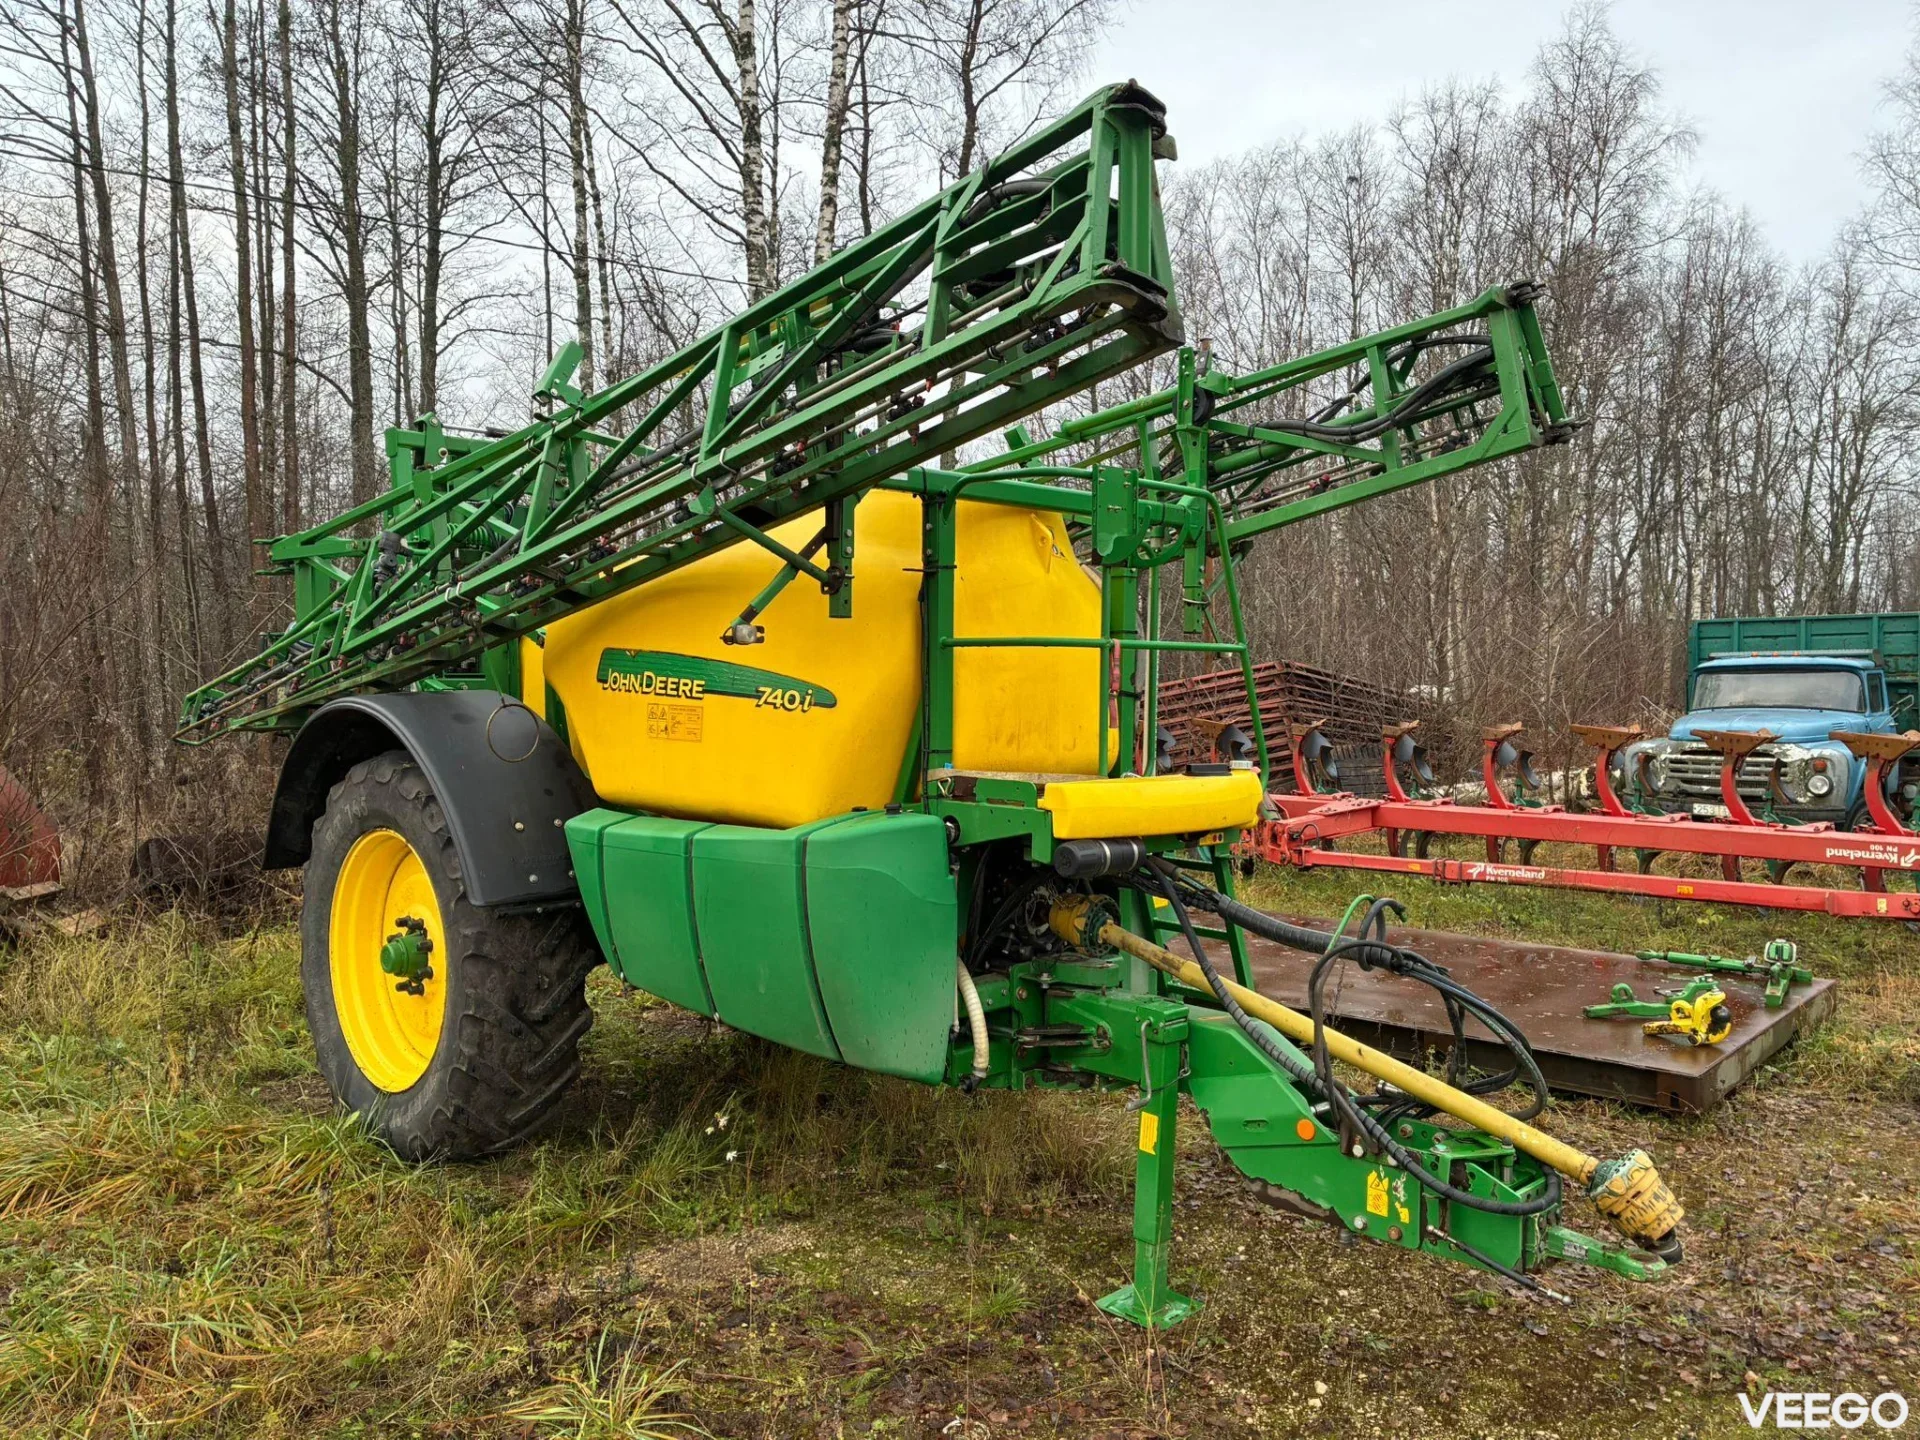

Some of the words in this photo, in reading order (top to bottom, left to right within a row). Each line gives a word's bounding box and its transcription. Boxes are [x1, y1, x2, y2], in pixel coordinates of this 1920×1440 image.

[602, 668, 641, 693] JOHN
[641, 671, 706, 700] DEERE
[1825, 847, 1899, 863] Kverneland
[1485, 864, 1546, 880] Kverneland
